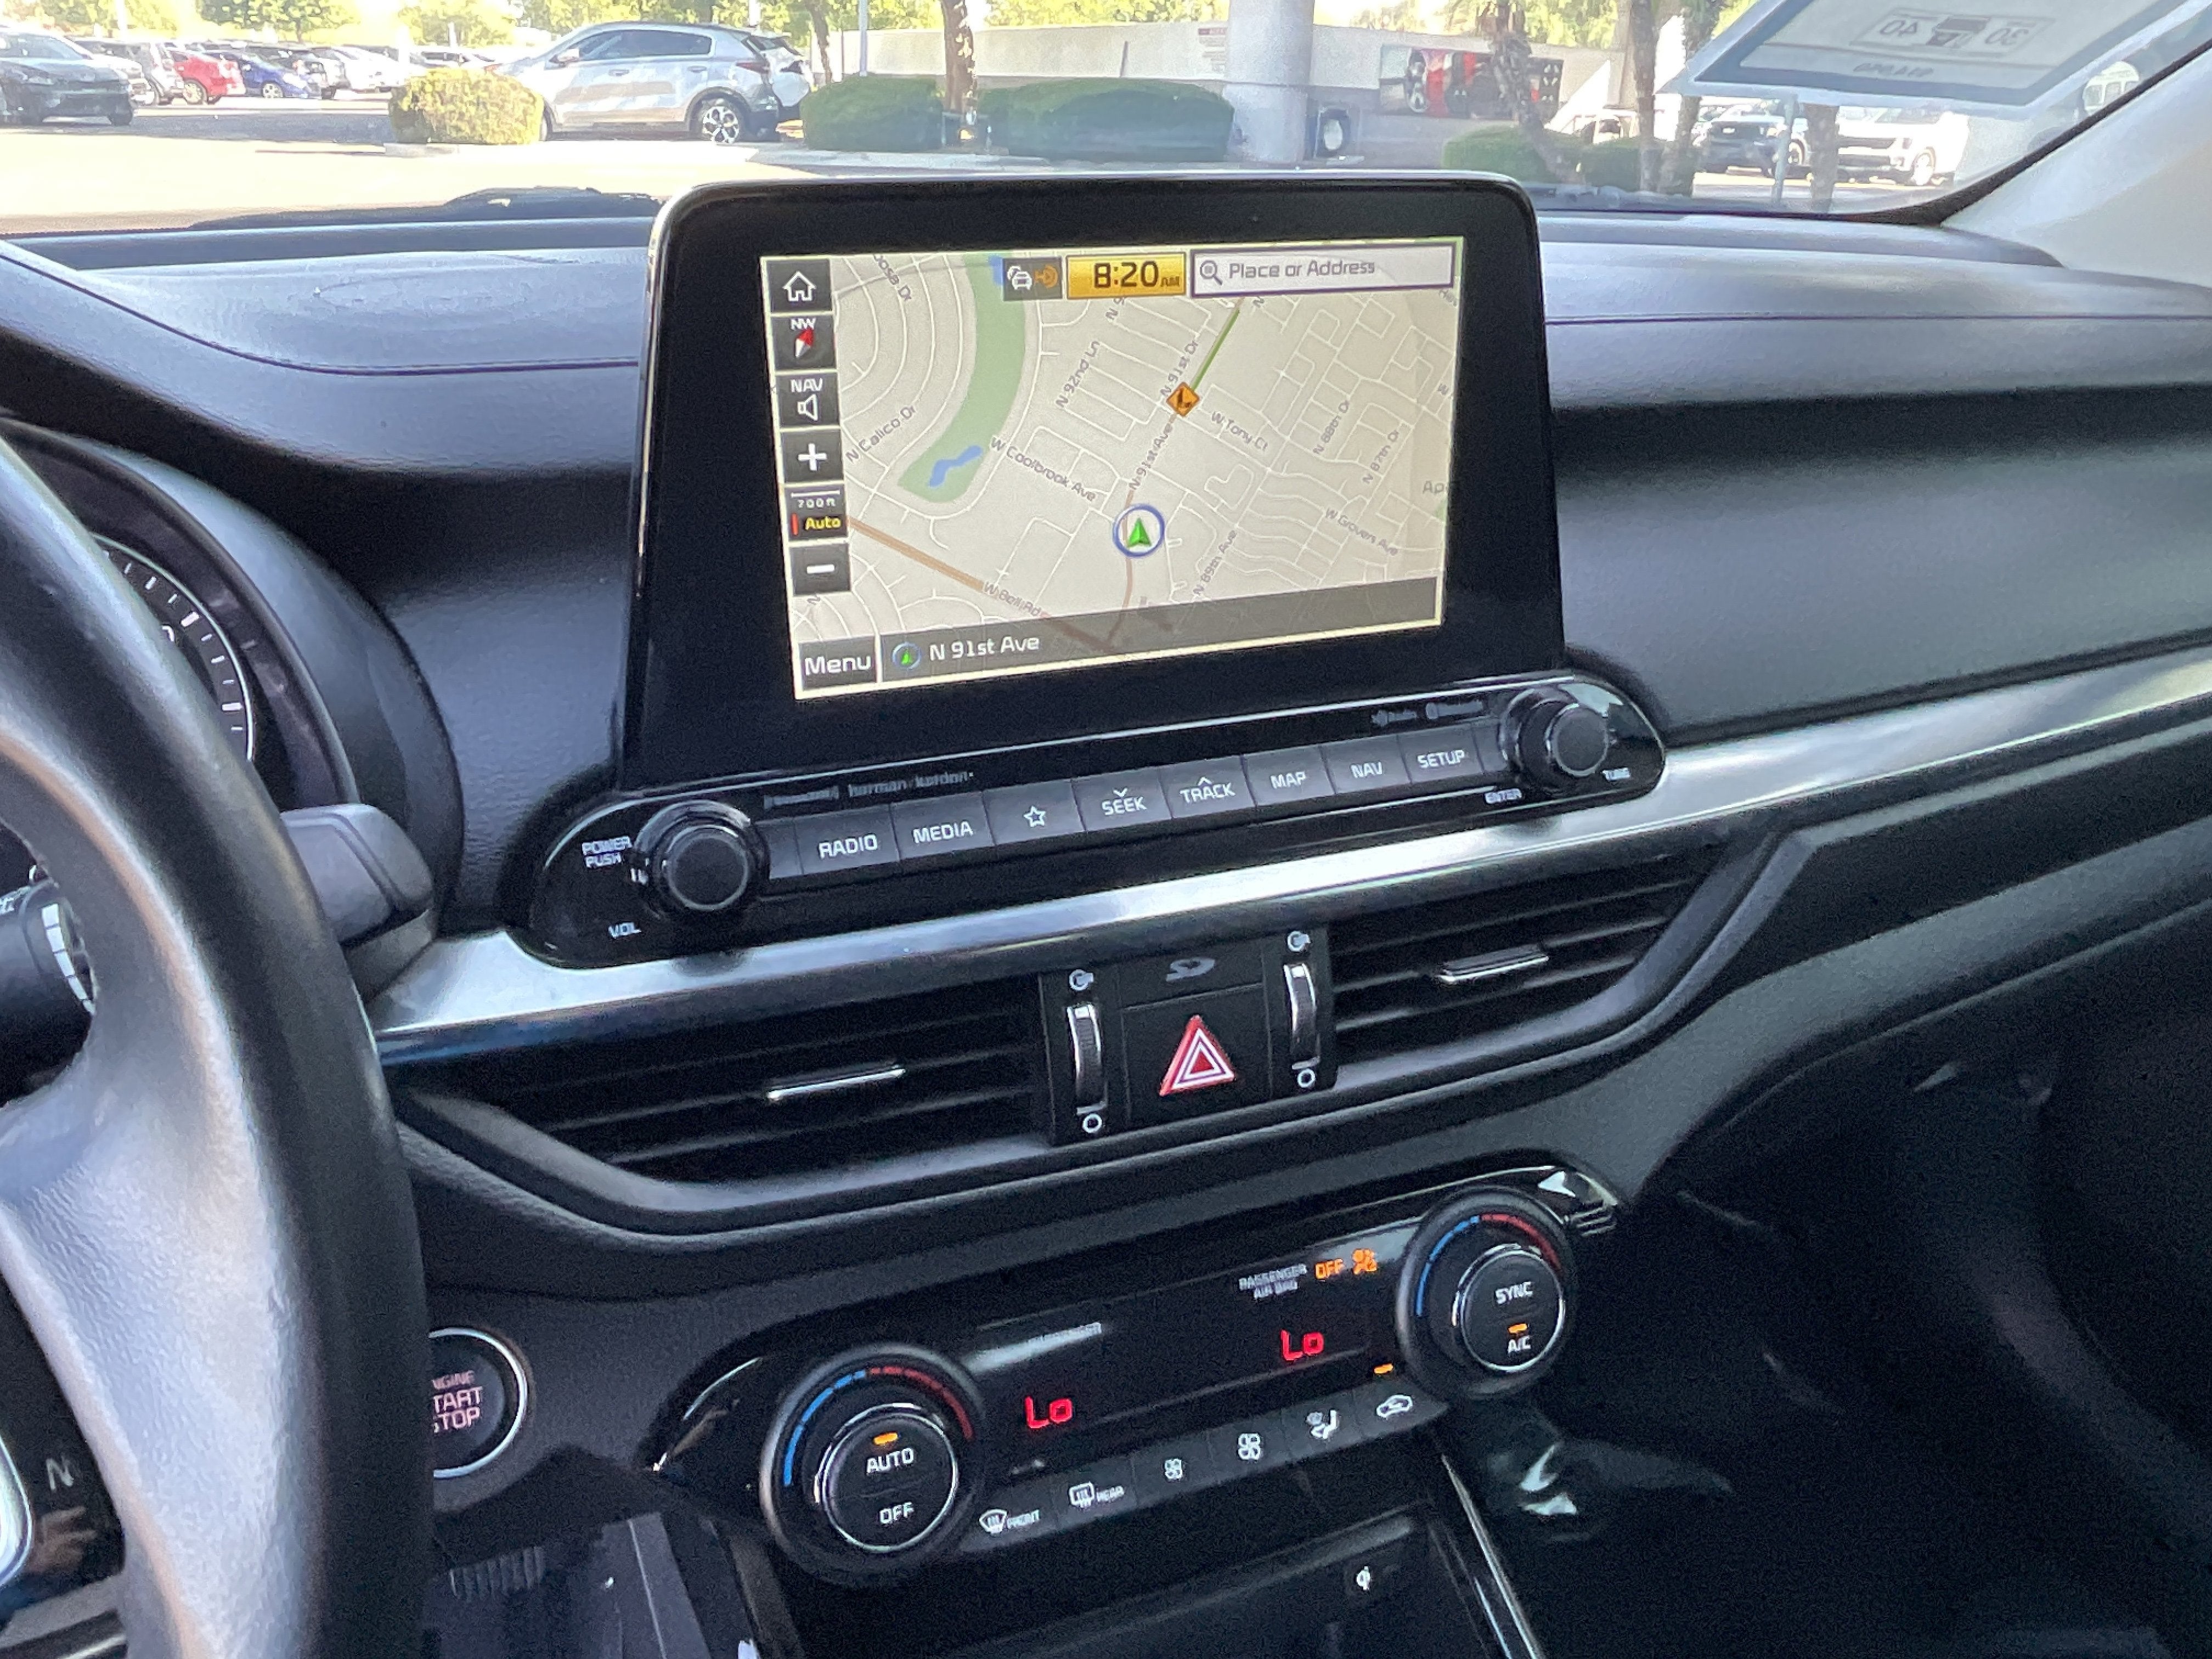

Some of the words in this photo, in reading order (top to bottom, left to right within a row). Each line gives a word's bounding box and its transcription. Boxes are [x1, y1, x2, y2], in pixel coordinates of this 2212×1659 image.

[1094, 261, 1159, 289] 8:20
[1229, 262, 1279, 279] Place
[1284, 264, 1302, 277] or
[1307, 260, 1375, 276] Address
[790, 318, 816, 330] NW
[791, 378, 823, 392] NAV
[1056, 394, 1069, 408] N
[1063, 359, 1090, 394] 92nd
[845, 450, 860, 464] N
[858, 417, 901, 453] Calico
[991, 437, 1006, 452] W
[1006, 446, 1069, 488] Coolbrook
[1071, 482, 1096, 501] Ave
[805, 516, 841, 530] Auto
[930, 644, 945, 660] N
[952, 638, 995, 658] 91st
[1000, 635, 1040, 652] Ave
[804, 656, 871, 675] Menu
[1351, 761, 1383, 778] NAV
[1417, 749, 1465, 768] SETUP
[1270, 771, 1306, 789] MAP
[1180, 782, 1236, 804] TRACK
[1101, 797, 1148, 816] SEEK
[912, 820, 974, 844] MEDIA
[819, 834, 878, 859] RADIO
[1314, 1258, 1344, 1280] OFF
[1495, 1281, 1533, 1305] SYNC
[432, 1386, 483, 1413] TART
[866, 1447, 915, 1474] AUTO
[879, 1502, 914, 1525] OFF
